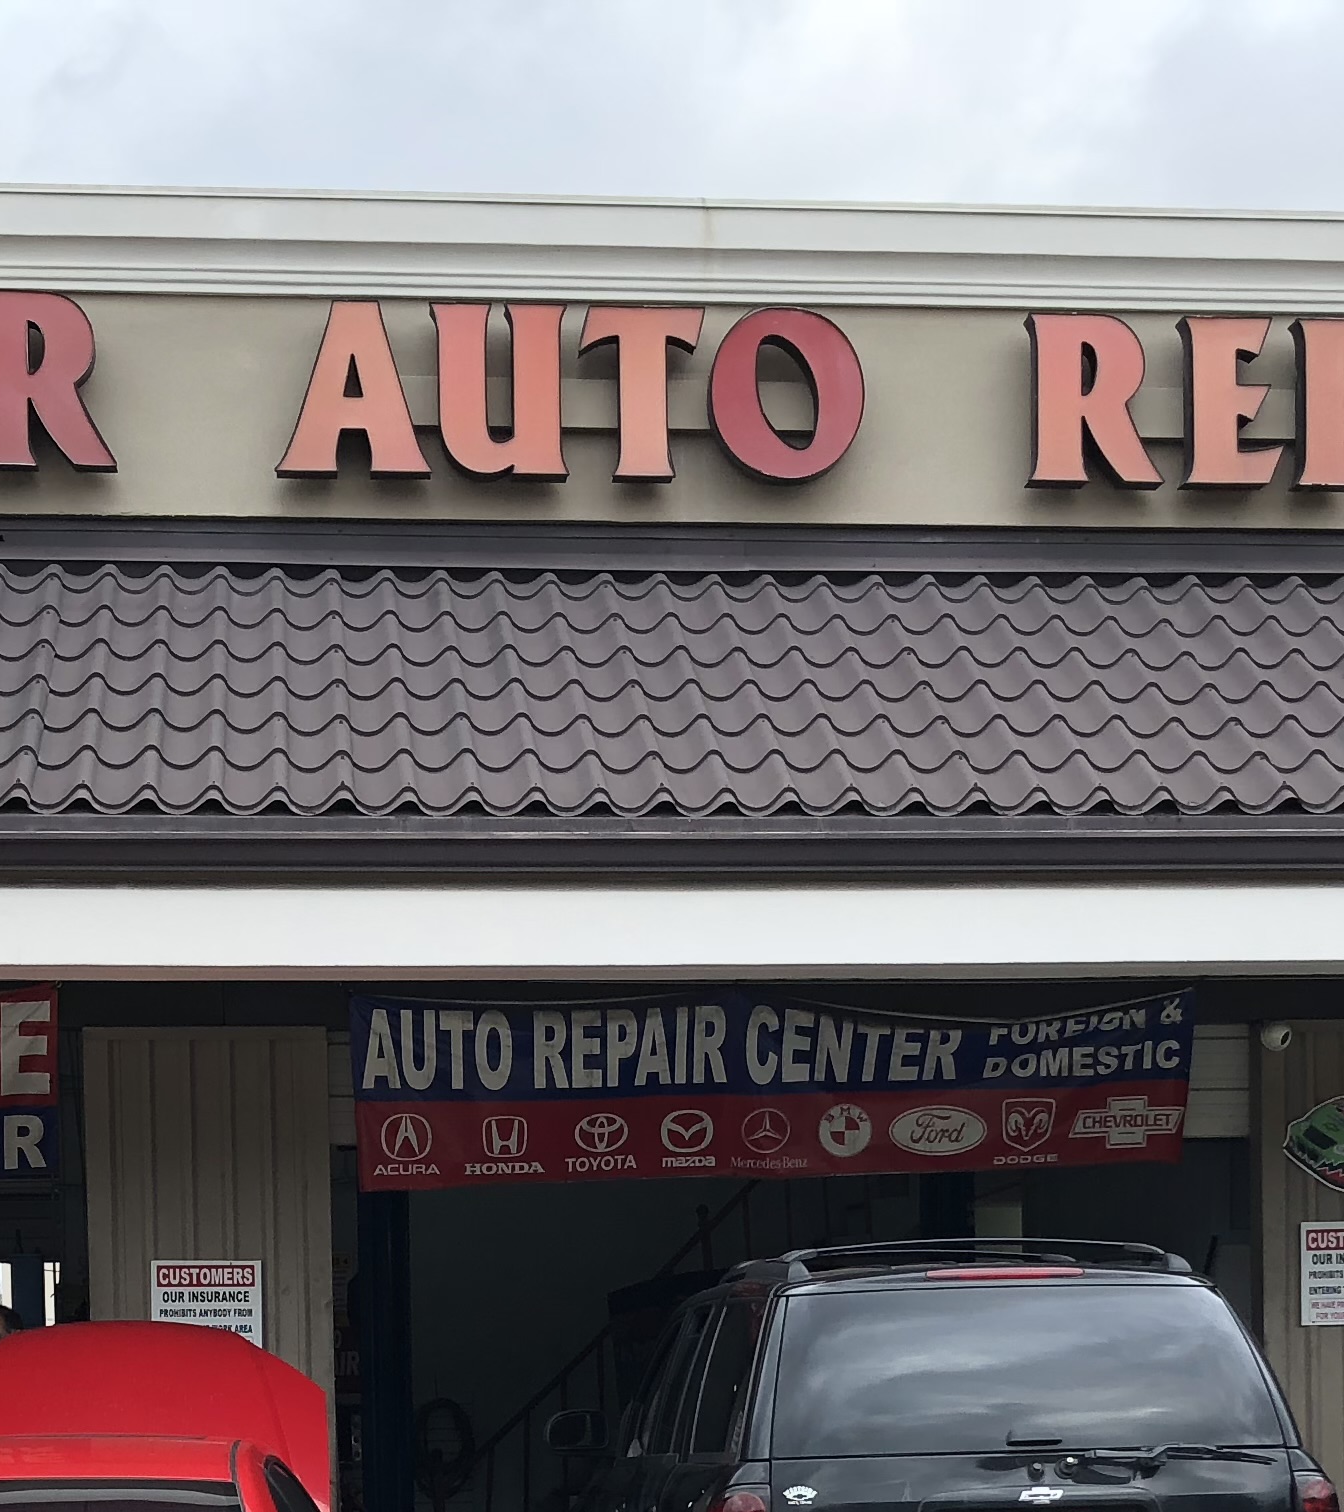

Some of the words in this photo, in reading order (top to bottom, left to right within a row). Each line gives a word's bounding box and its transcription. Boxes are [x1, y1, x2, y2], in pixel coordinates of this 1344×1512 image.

[275, 300, 866, 484] AUTO
[988, 1008, 1147, 1046] FOREIGN
[1160, 997, 1183, 1025] &
[362, 1008, 514, 1091] AUTO
[532, 1004, 729, 1089] REPAIR
[745, 1004, 963, 1086] CENTER
[982, 1039, 1181, 1079] DOMESTIC
[823, 1106, 868, 1124] BMW
[1082, 1112, 1174, 1129] CHEVROLET
[910, 1112, 966, 1145] Ford
[565, 1154, 638, 1173] TOYOTA
[730, 1155, 808, 1170] Mercedes-Benz
[993, 1153, 1059, 1165] DODGE
[373, 1163, 441, 1176] ACURA
[464, 1161, 546, 1176] HONDA
[1311, 1253, 1333, 1265] OUR
[159, 1267, 253, 1285] CUSTOMERS
[162, 1291, 185, 1303] OUR
[188, 1290, 250, 1303] INSURANCE
[159, 1308, 196, 1318] PROHIBITS
[198, 1308, 232, 1318] ANYBODY
[233, 1308, 253, 1318] FROM
[234, 1324, 253, 1334] AREA
